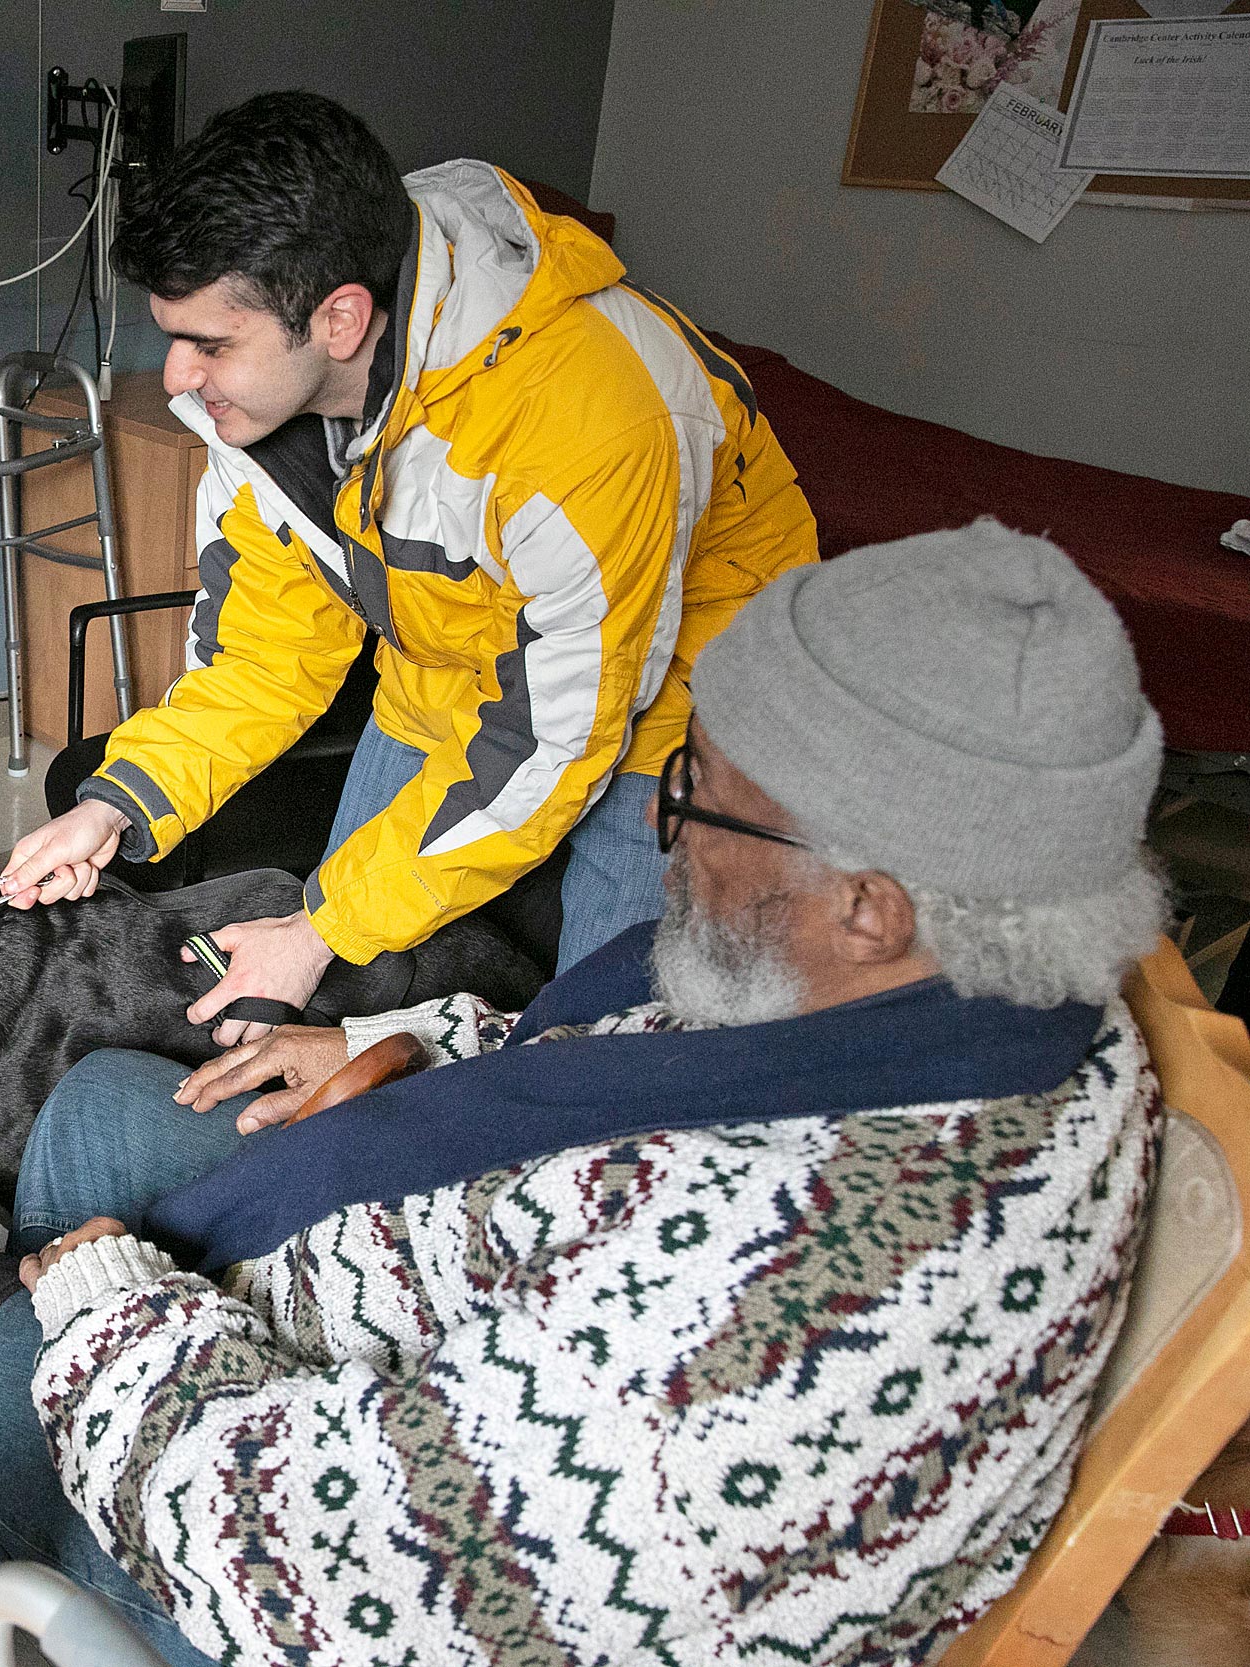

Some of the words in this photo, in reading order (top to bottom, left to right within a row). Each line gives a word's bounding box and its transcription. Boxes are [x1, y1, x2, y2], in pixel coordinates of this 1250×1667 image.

[1150, 32, 1180, 42] Center
[1181, 31, 1217, 42] Activity
[1134, 55, 1154, 64] Luck
